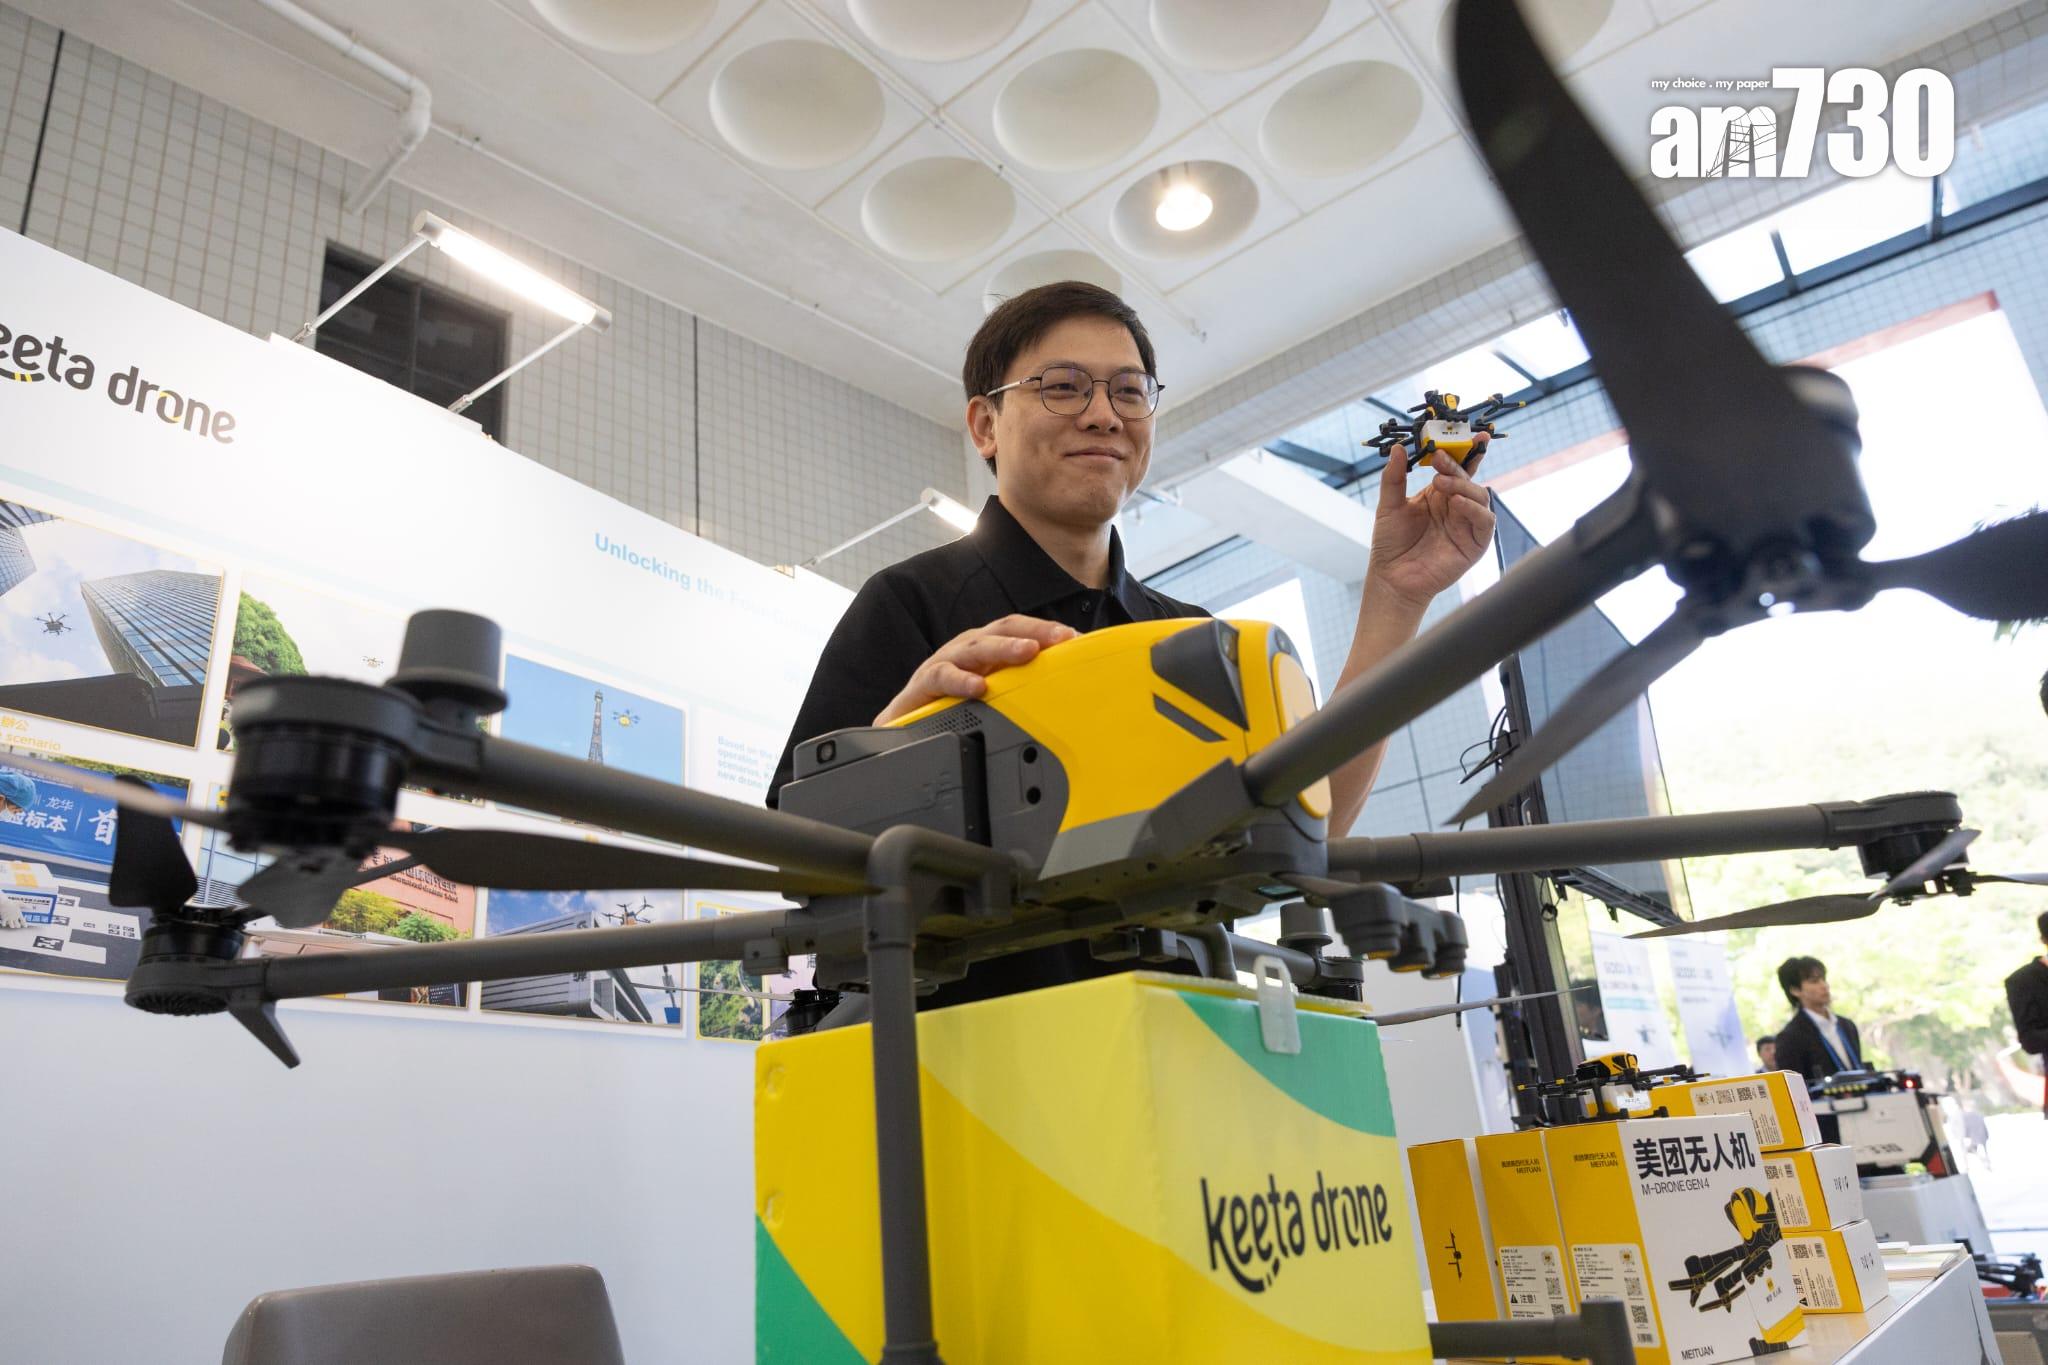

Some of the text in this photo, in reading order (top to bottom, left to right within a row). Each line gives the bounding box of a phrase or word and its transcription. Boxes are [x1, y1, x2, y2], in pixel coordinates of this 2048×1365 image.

[107, 365, 236, 444] drone
[594, 532, 692, 591] Unlocking
[1516, 1166, 1542, 1174] MEITUAN
[1590, 1160, 1619, 1168] MEITUAN
[1633, 1131, 1756, 1180] 美团无人机
[1641, 1178, 1710, 1196] M-DRONE GEN 4
[1200, 1170, 1392, 1294] keeta drone
[1681, 1345, 1714, 1361] MEITUAN
